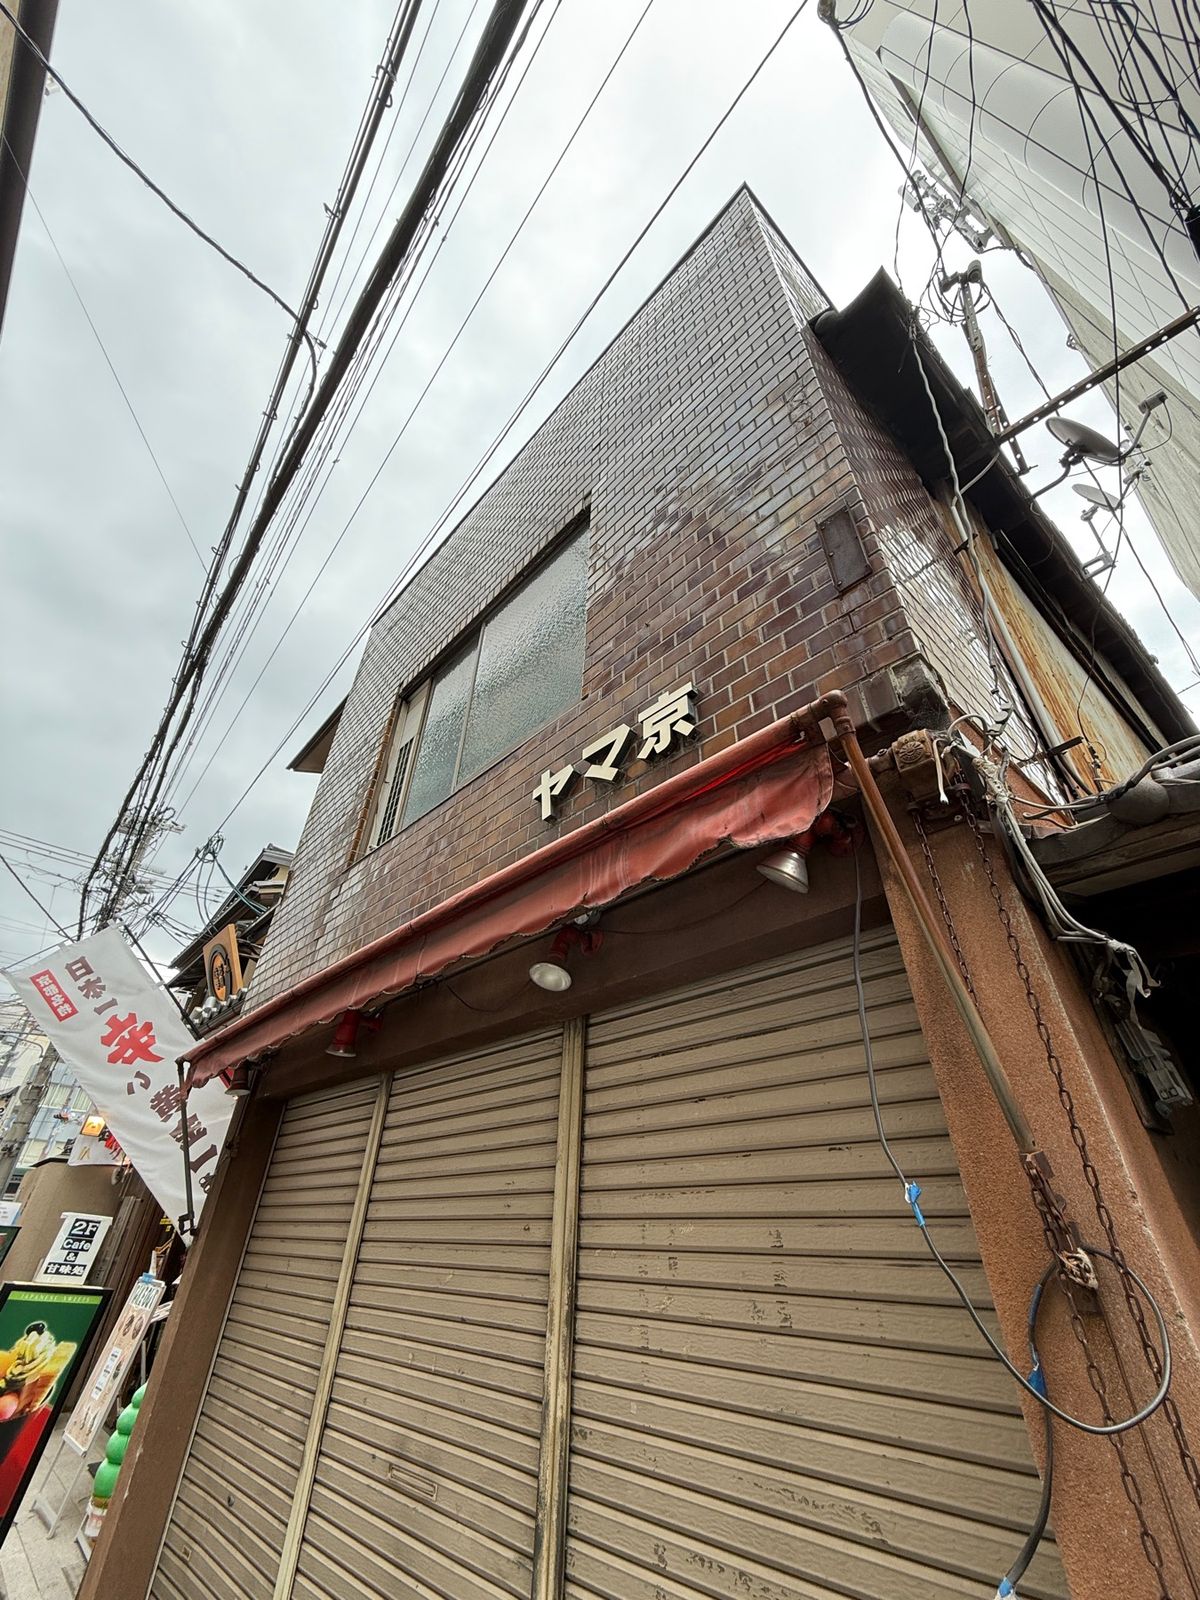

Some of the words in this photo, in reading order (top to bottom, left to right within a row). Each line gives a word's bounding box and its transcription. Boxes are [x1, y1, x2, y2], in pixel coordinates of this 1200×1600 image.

[533, 682, 698, 822] ヤマ京
[71, 1220, 100, 1236] 2F
[63, 1239, 92, 1251] Cafe
[66, 1252, 77, 1261] &
[46, 1263, 85, 1276] 甘味処
